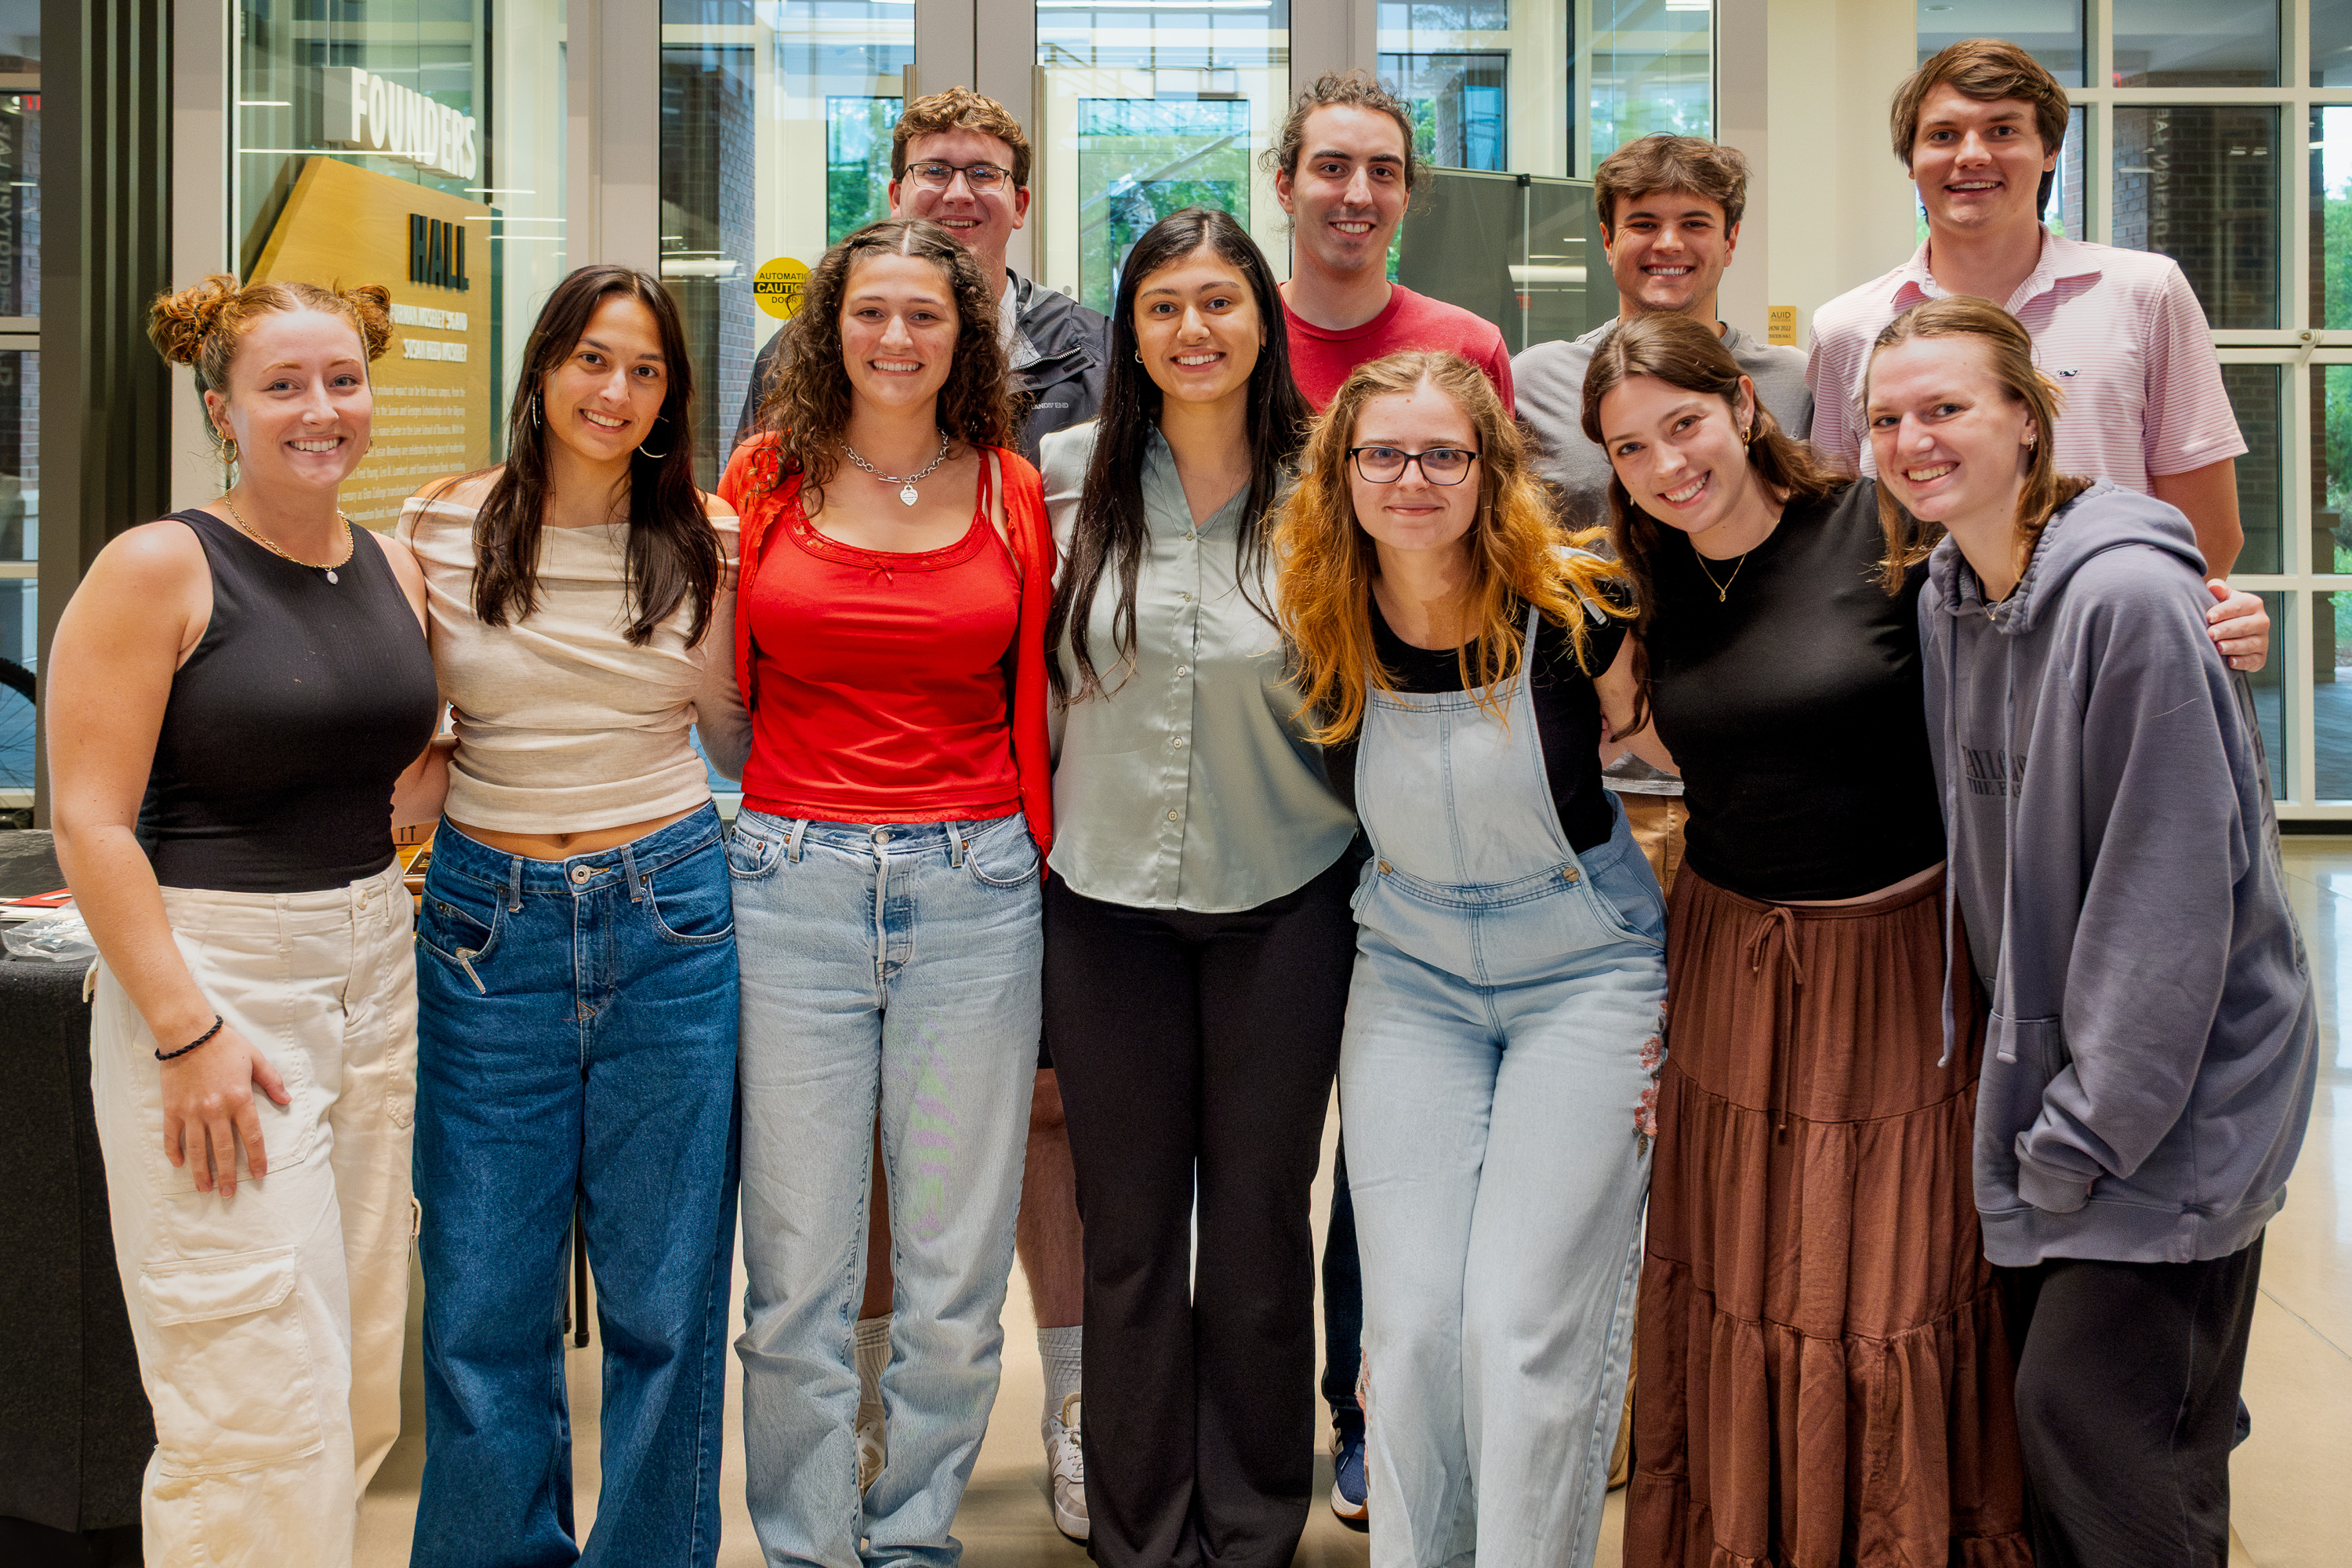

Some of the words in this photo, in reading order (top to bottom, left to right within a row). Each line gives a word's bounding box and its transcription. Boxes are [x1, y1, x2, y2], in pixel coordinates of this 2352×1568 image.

[351, 67, 477, 180] FOUNDERS
[407, 213, 470, 292] HALL
[757, 282, 802, 293] CAUTIO
